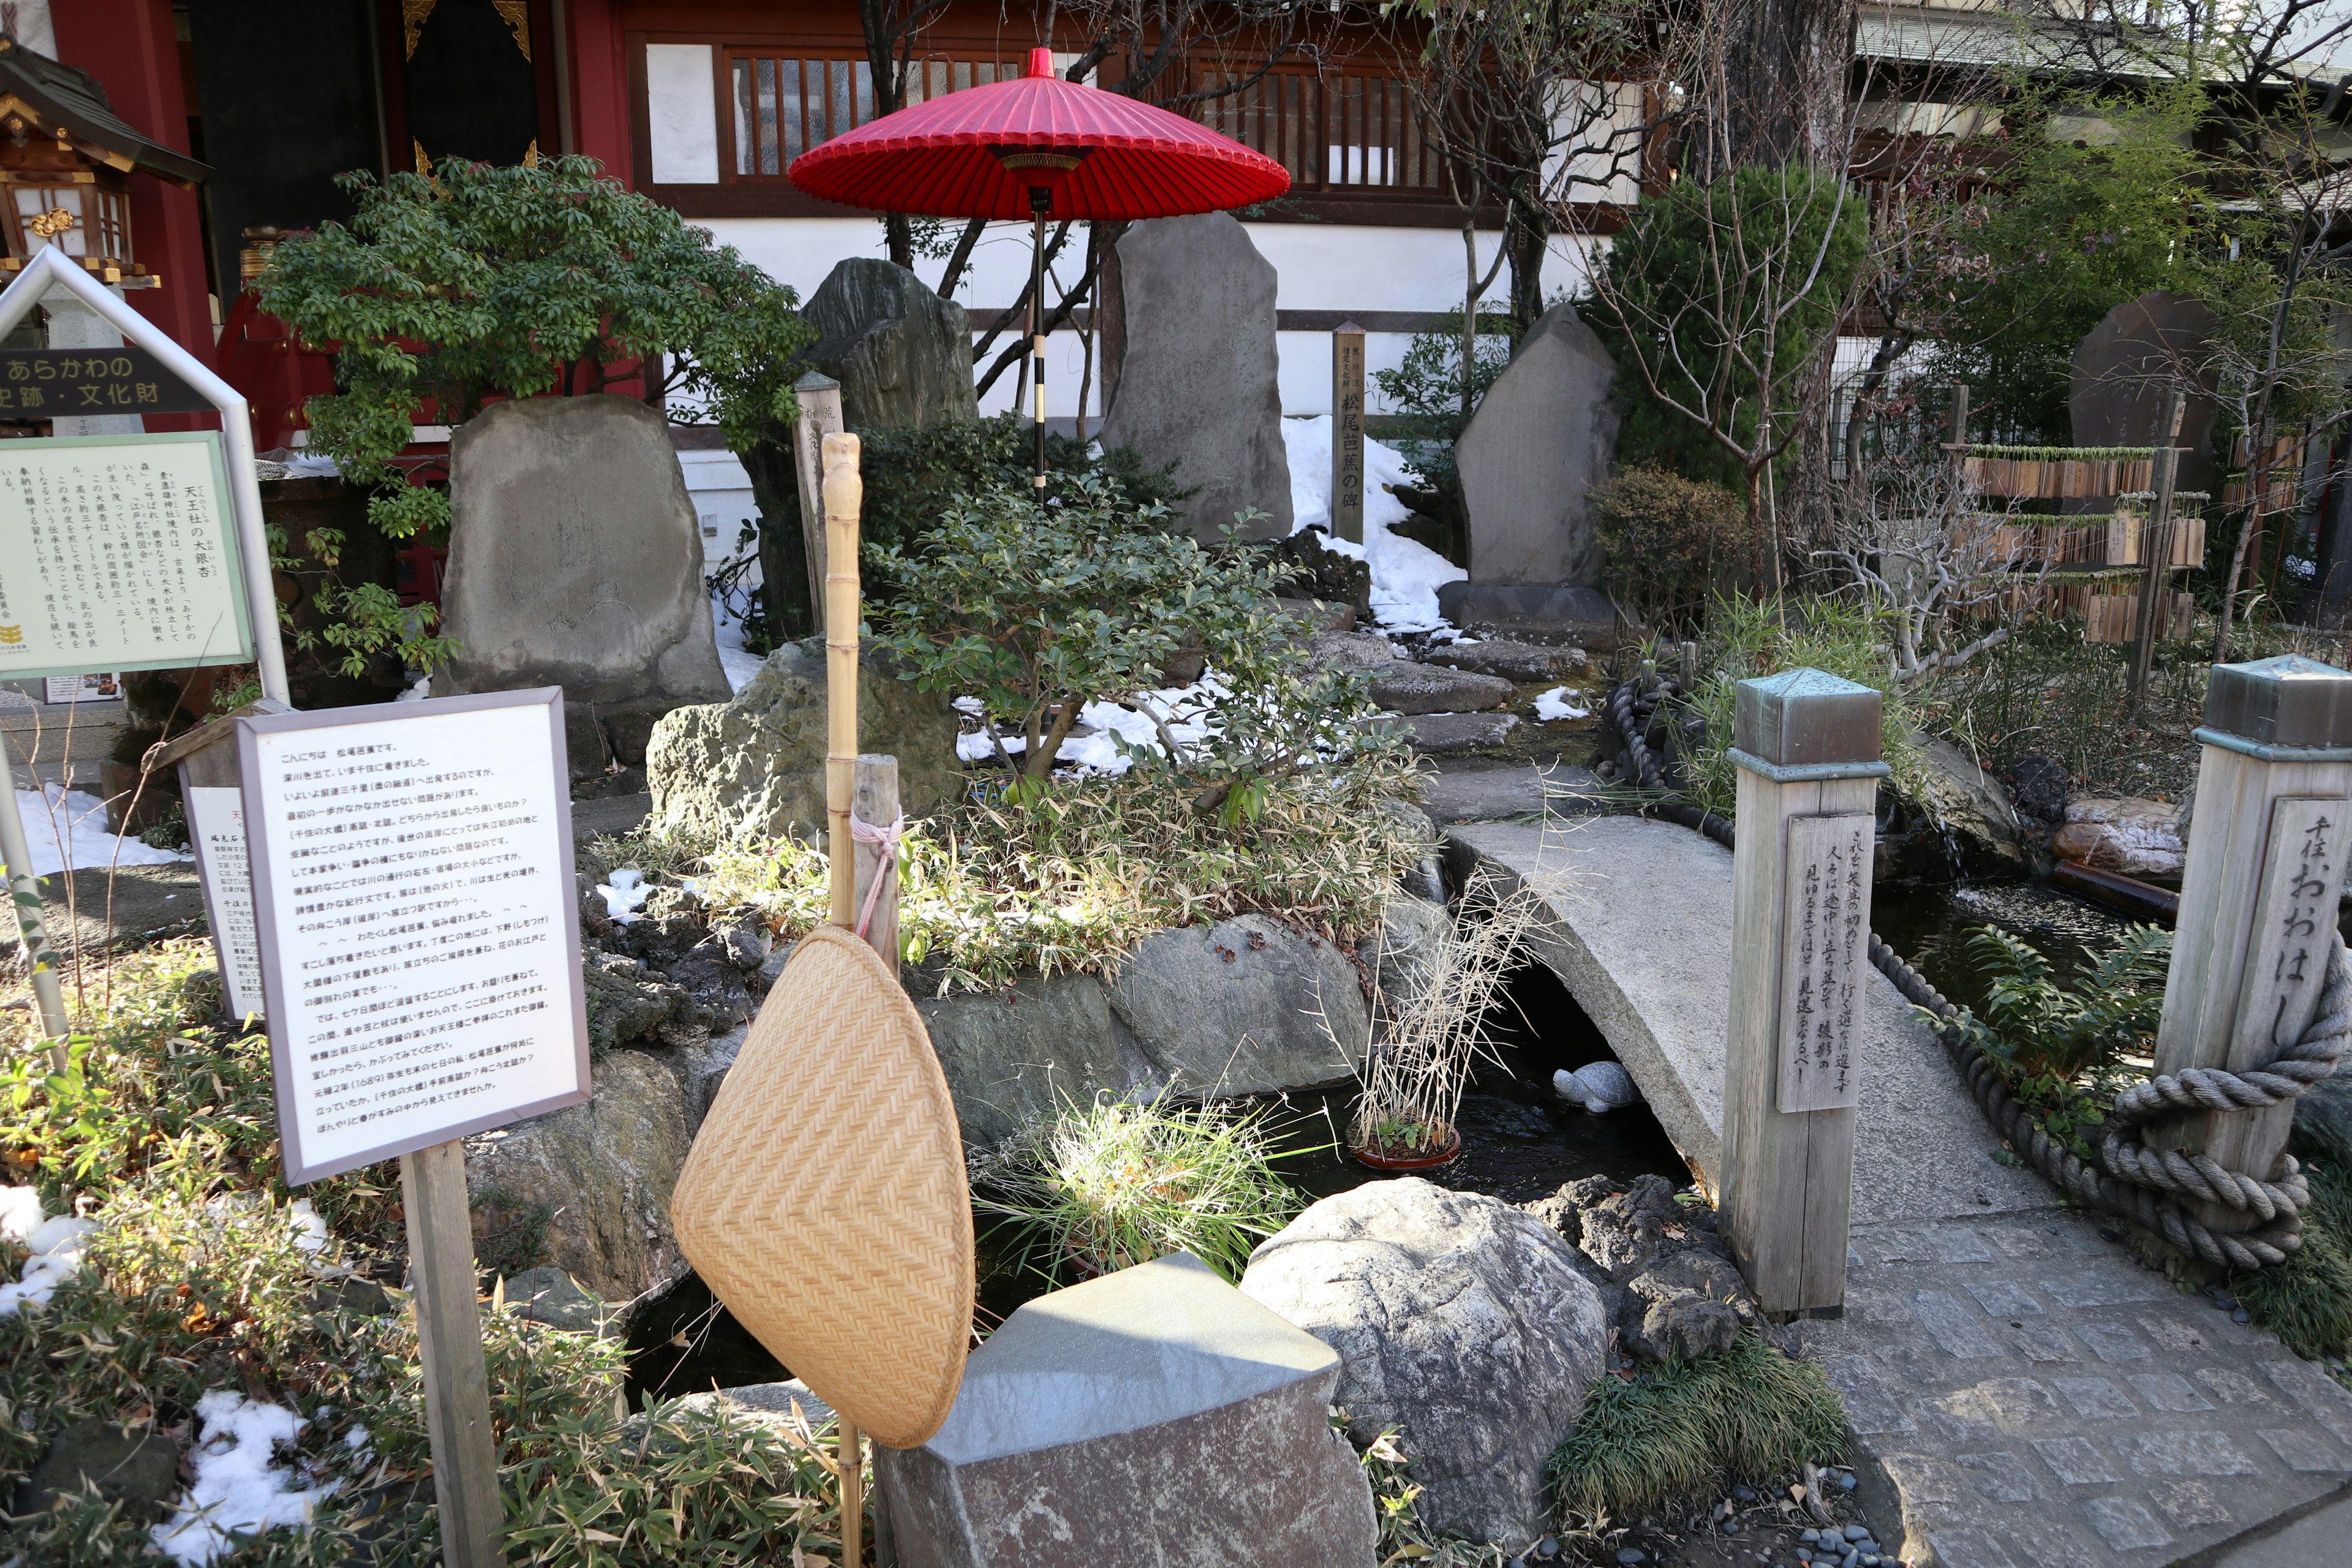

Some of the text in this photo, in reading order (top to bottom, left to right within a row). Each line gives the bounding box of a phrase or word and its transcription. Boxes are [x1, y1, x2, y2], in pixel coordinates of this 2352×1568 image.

[6, 356, 133, 380] あらかわの
[0, 382, 159, 407] 史跡・文化財
[805, 407, 820, 461] 指文化財
[1341, 394, 1360, 510] 松尾芭蕉の碑
[183, 486, 211, 578] 天王社の大銀杏
[281, 743, 396, 763] こんにちは 松尾芭蕉です。
[286, 788, 478, 821] 最初の一歩がなかなか出せない問題があります。
[2272, 815, 2331, 1047] 千住おおはし
